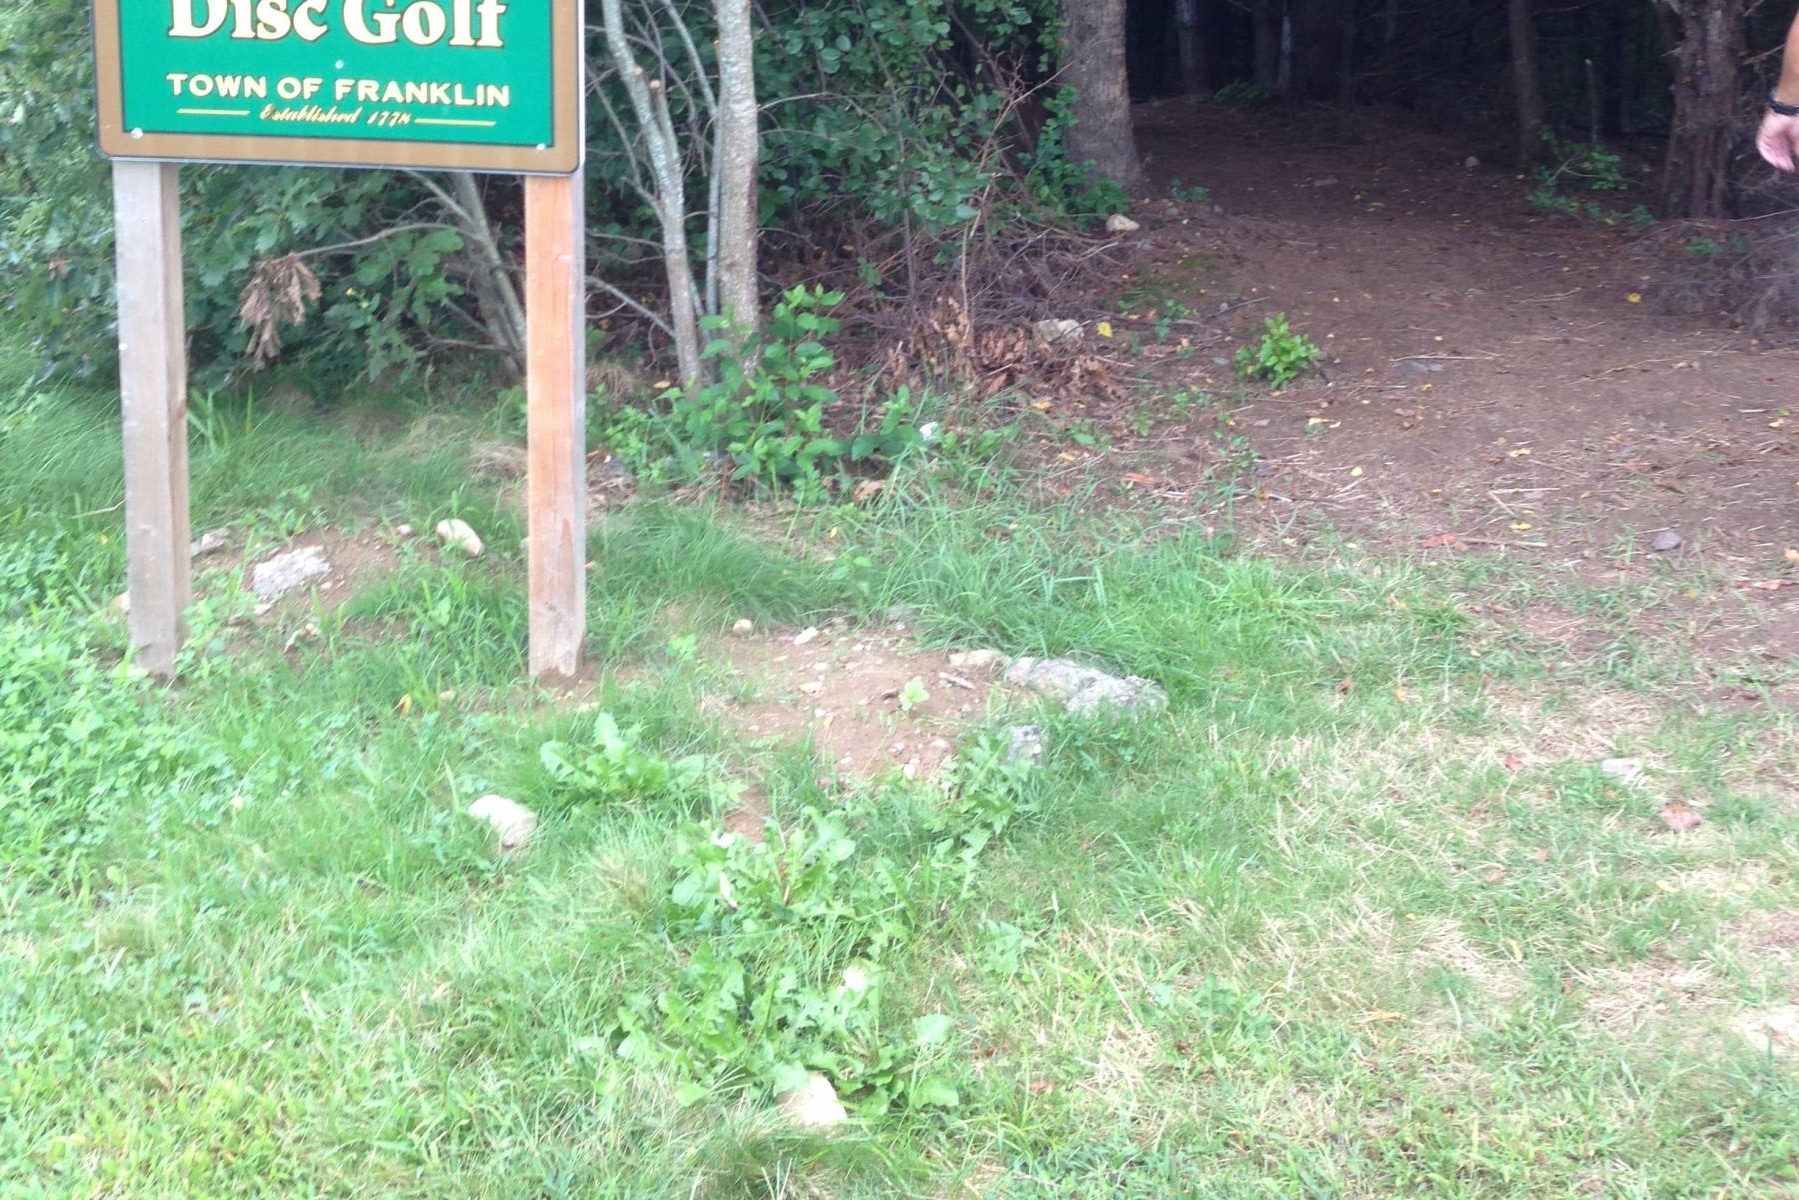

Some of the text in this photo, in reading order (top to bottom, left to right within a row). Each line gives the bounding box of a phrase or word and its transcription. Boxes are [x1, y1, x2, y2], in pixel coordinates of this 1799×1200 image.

[166, 73, 511, 107] TOWN OF FRANKLIN
[259, 104, 363, 124] Established
